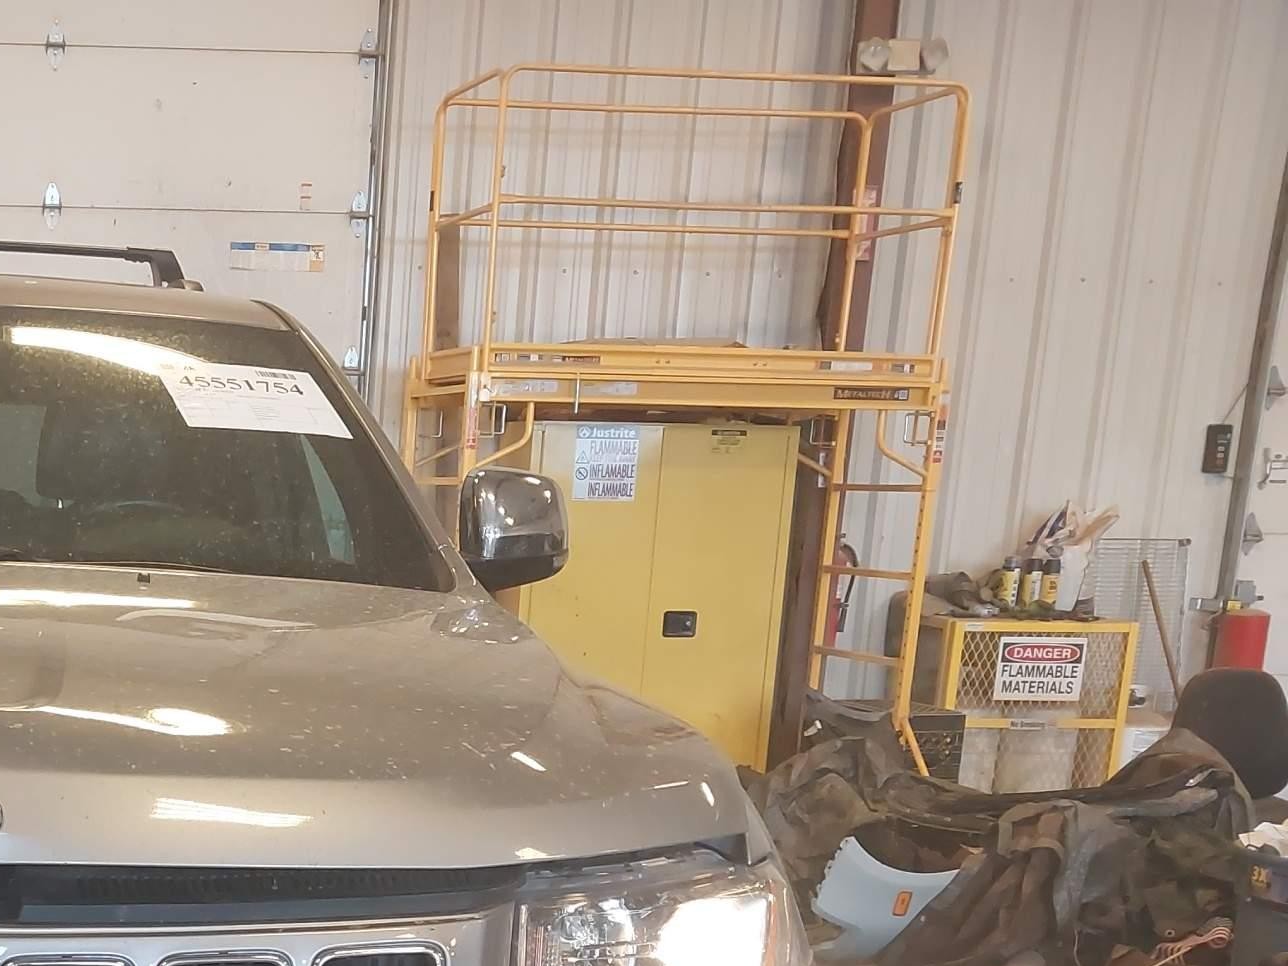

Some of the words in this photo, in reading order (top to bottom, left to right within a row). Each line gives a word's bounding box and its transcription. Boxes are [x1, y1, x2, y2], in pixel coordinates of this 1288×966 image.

[179, 375, 304, 396] 45551754
[592, 427, 636, 438] Justrite
[591, 440, 637, 455] FLAMMABLE
[589, 463, 635, 479] INFLAMABLE
[587, 482, 634, 497] INFLAMMABLE
[1013, 647, 1072, 659] DANGER
[1001, 664, 1079, 679] FLAMMABLE
[1001, 680, 1074, 694] MATERIALS
